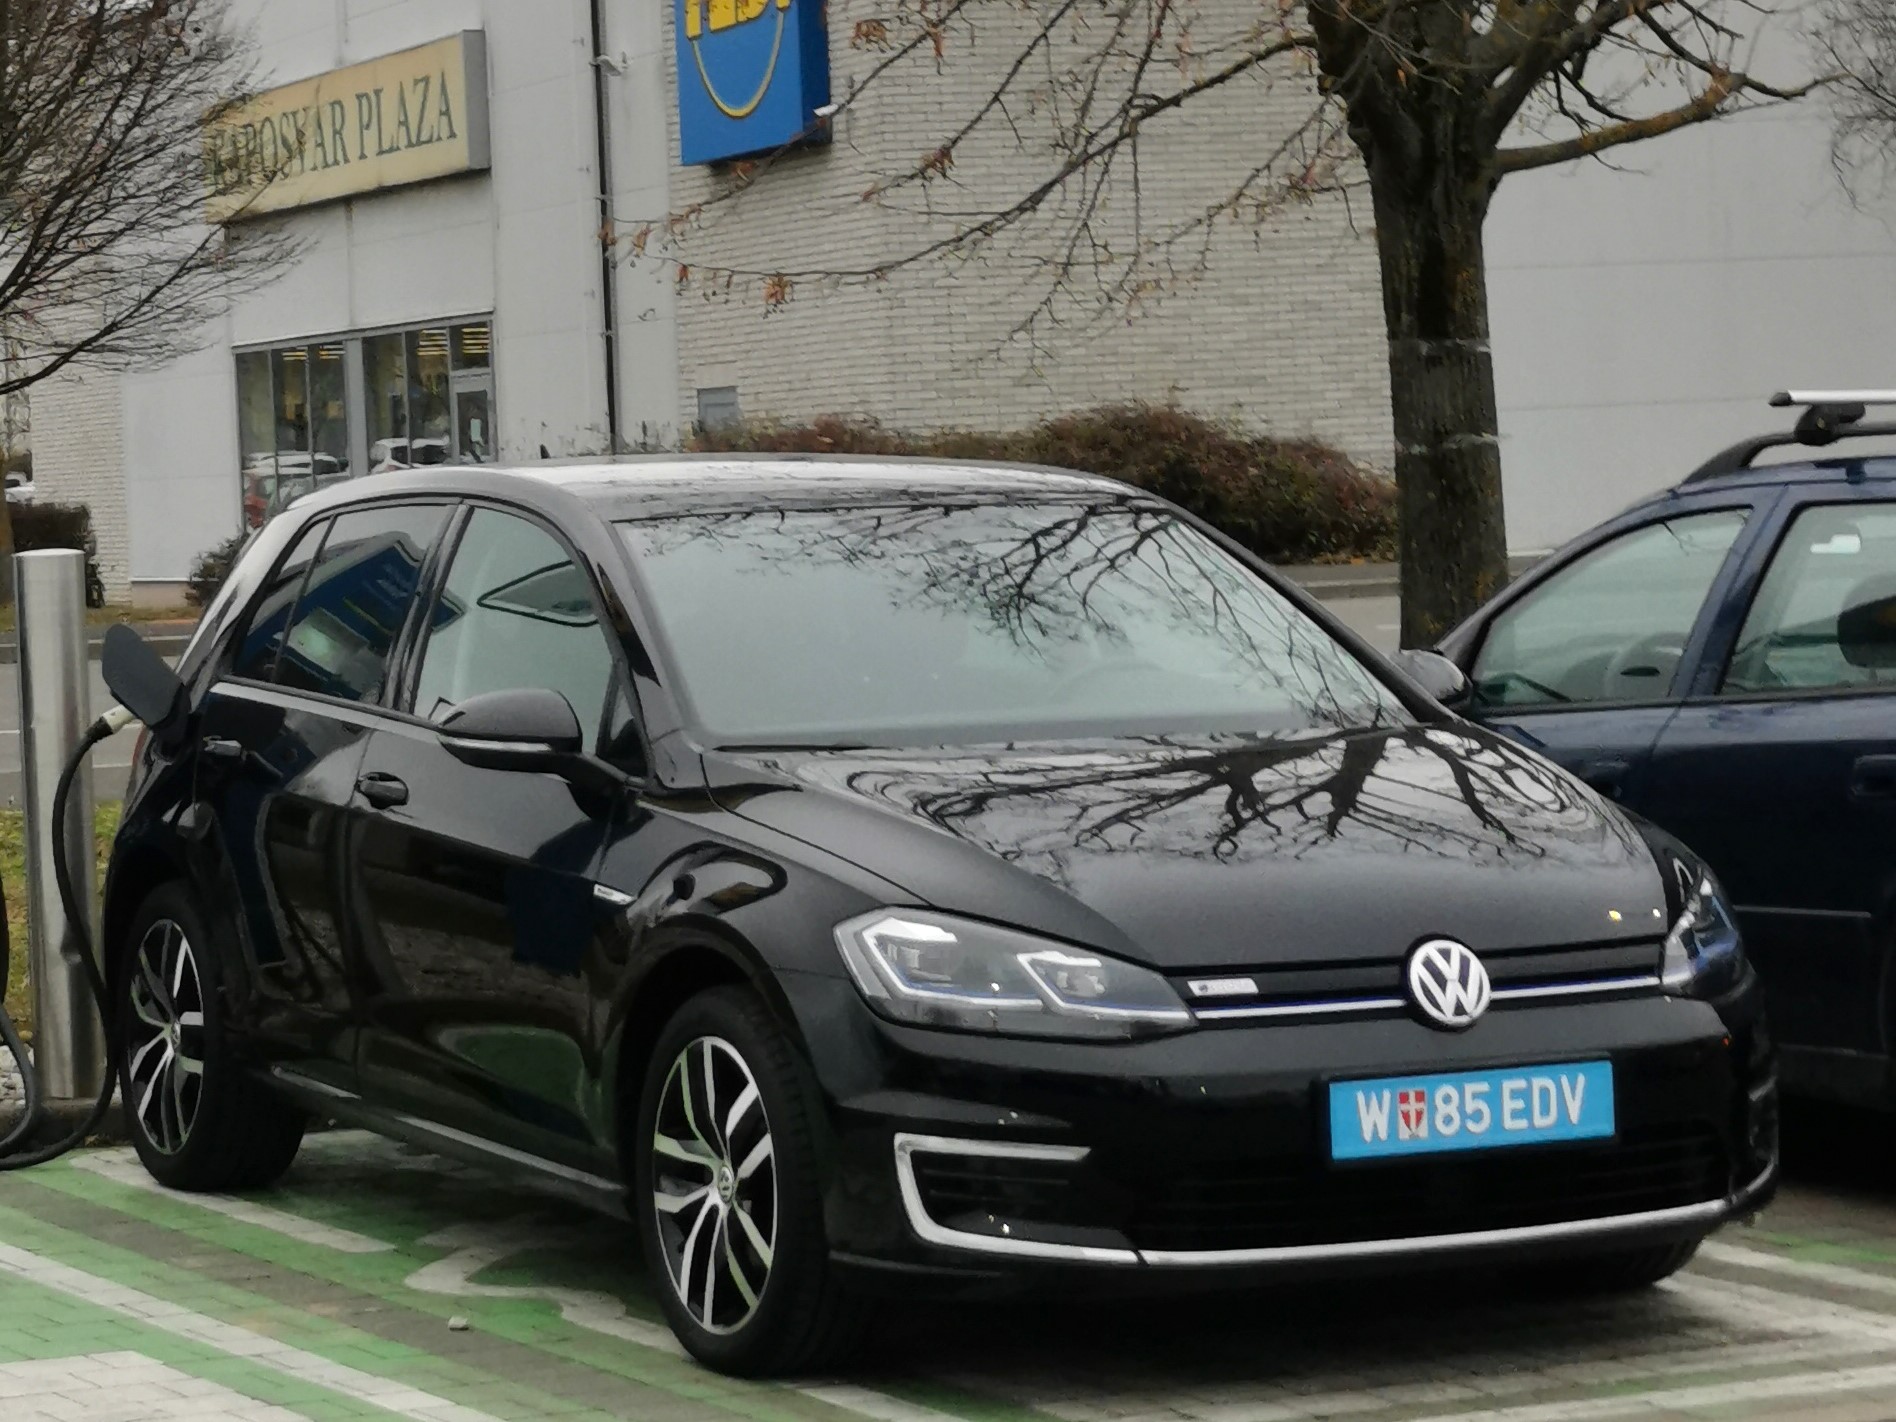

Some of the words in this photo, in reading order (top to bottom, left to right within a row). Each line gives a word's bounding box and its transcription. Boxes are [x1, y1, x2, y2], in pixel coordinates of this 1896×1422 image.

[355, 71, 458, 160] PLAZA
[1410, 939, 1491, 1025] VW
[1356, 1088, 1392, 1143] W
[1434, 1081, 1492, 1136] 85
[1501, 1072, 1586, 1130] EDV
